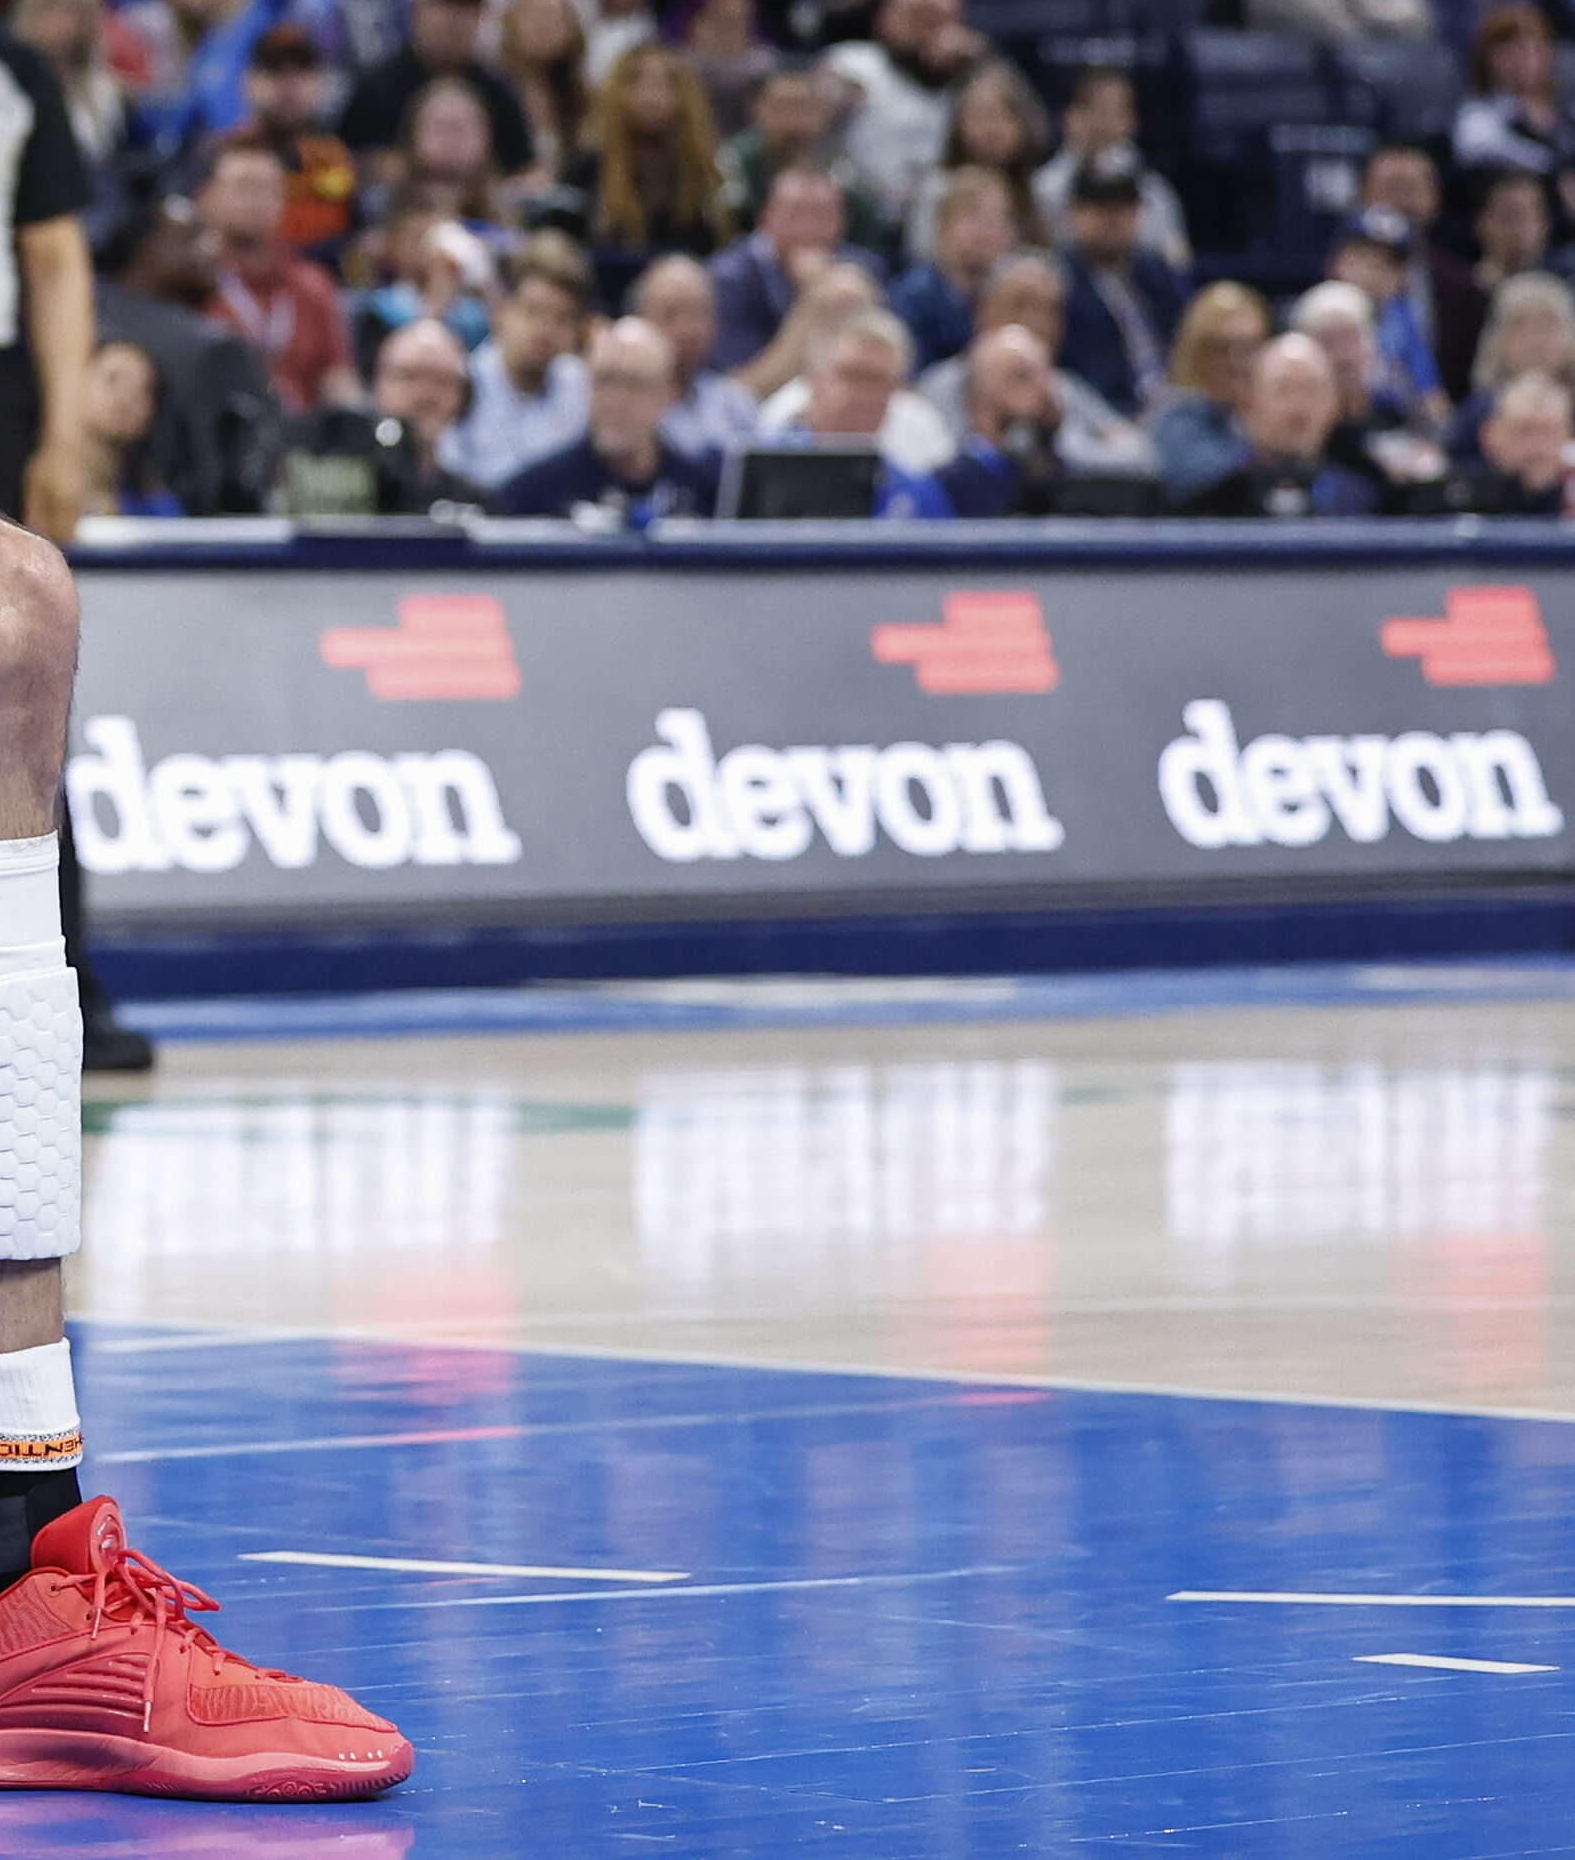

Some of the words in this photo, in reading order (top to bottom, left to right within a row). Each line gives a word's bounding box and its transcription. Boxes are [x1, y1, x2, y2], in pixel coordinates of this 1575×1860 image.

[68, 715, 519, 873] devon
[629, 709, 1060, 859] devon
[1160, 701, 1559, 845] devon
